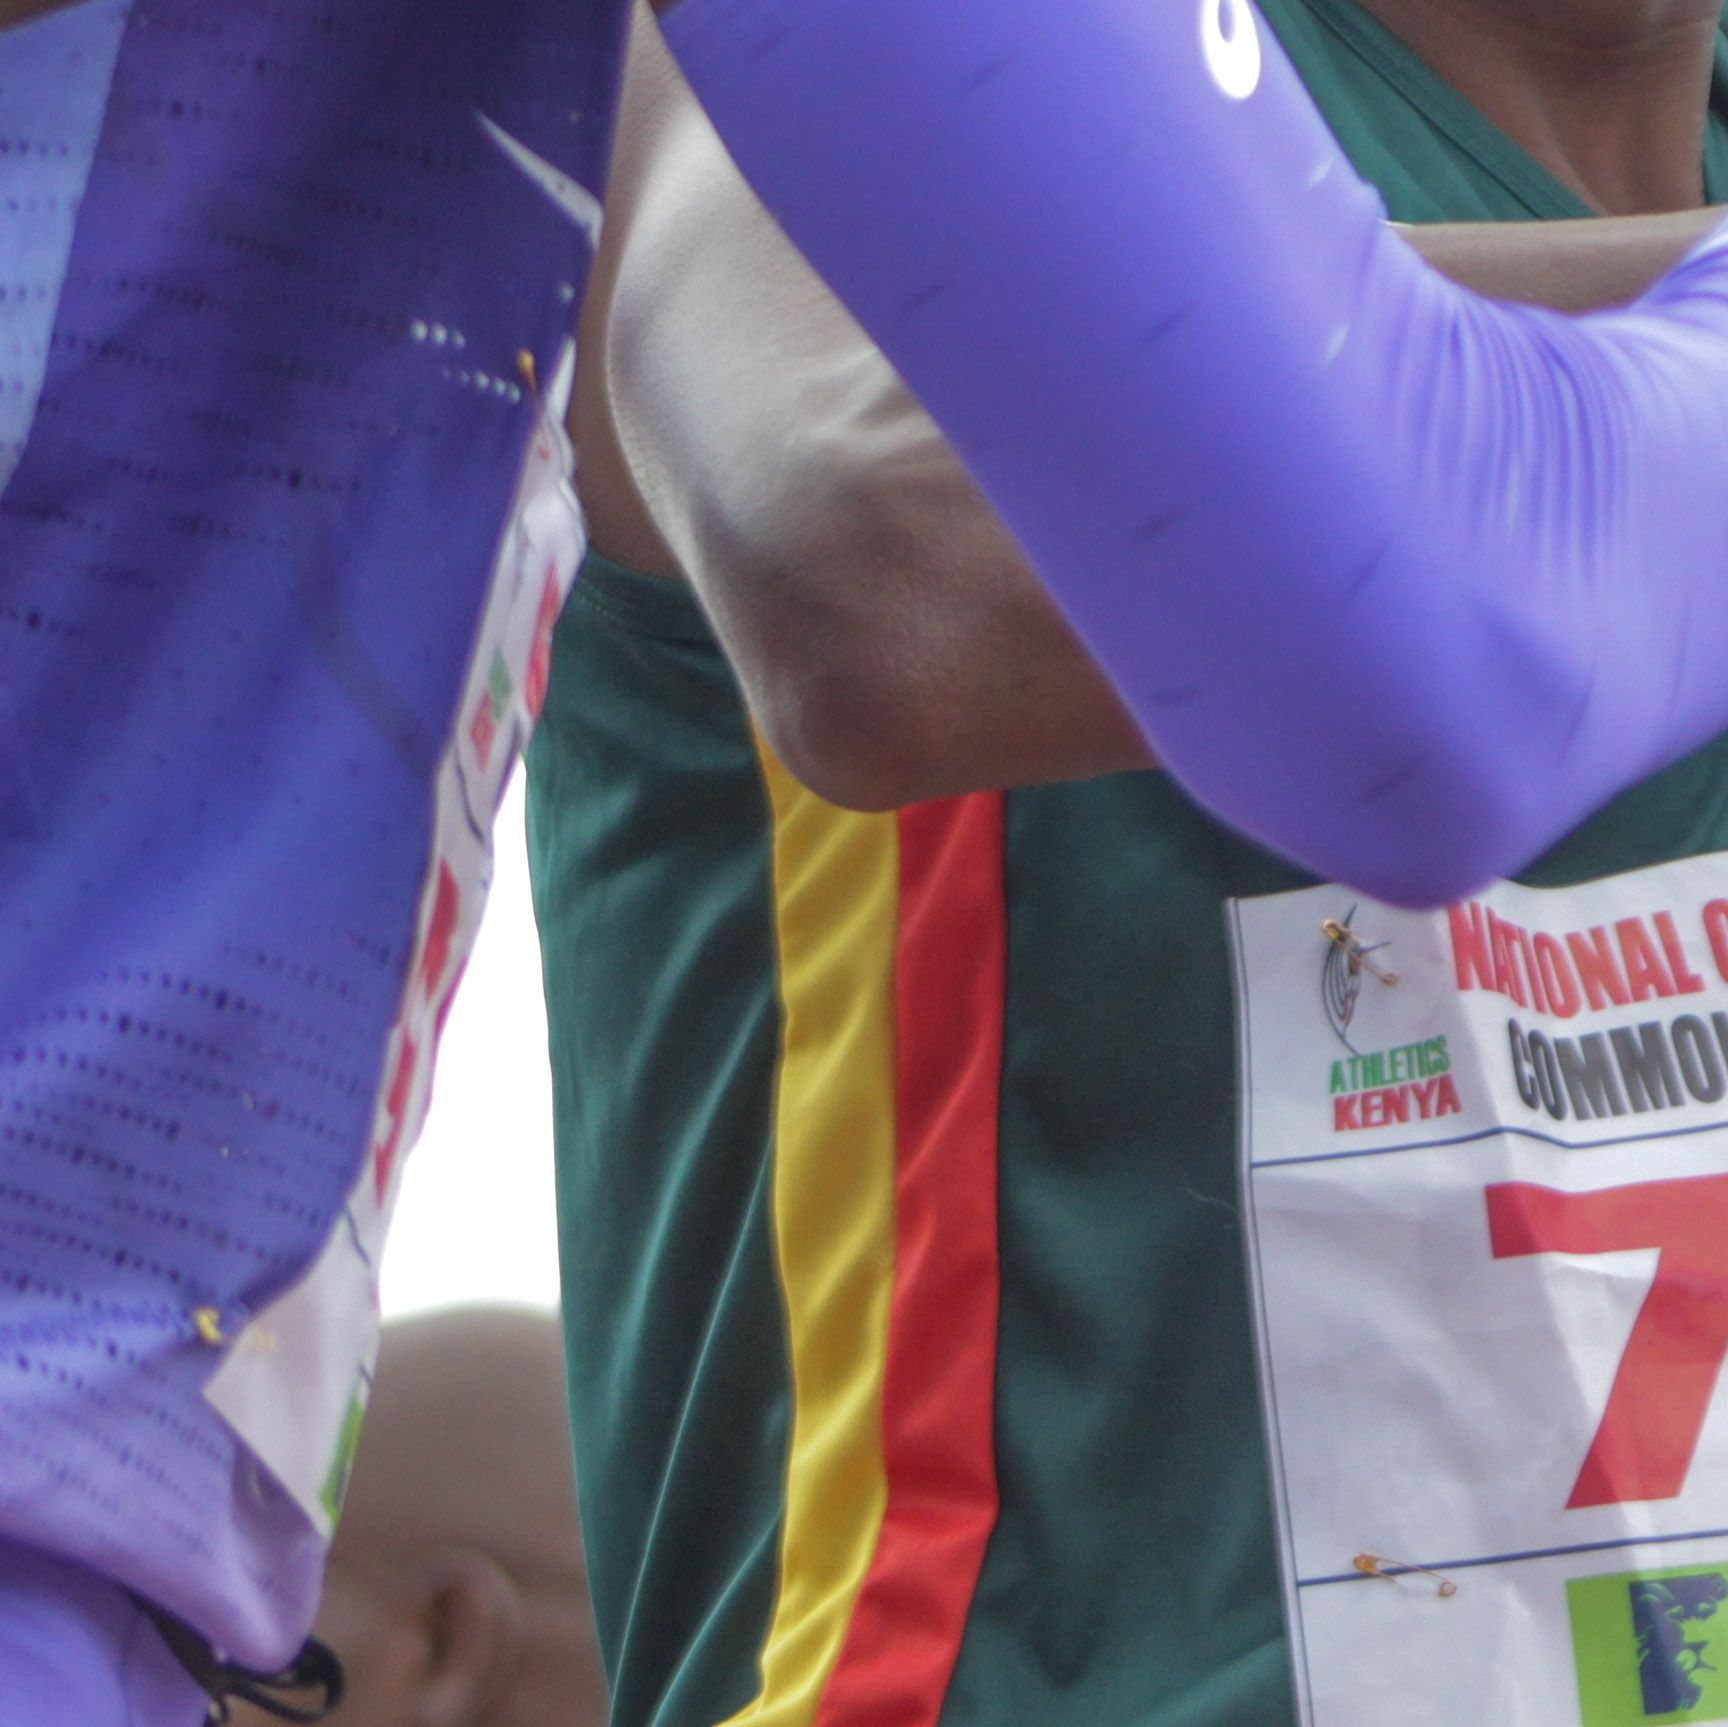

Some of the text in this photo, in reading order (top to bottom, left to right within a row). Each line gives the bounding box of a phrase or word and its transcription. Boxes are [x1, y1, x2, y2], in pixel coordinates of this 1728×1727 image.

[1447, 899, 1706, 1019] NATIONAL
[1328, 1034, 1450, 1094] ATHLETICS
[1333, 1072, 1463, 1133] KENYA
